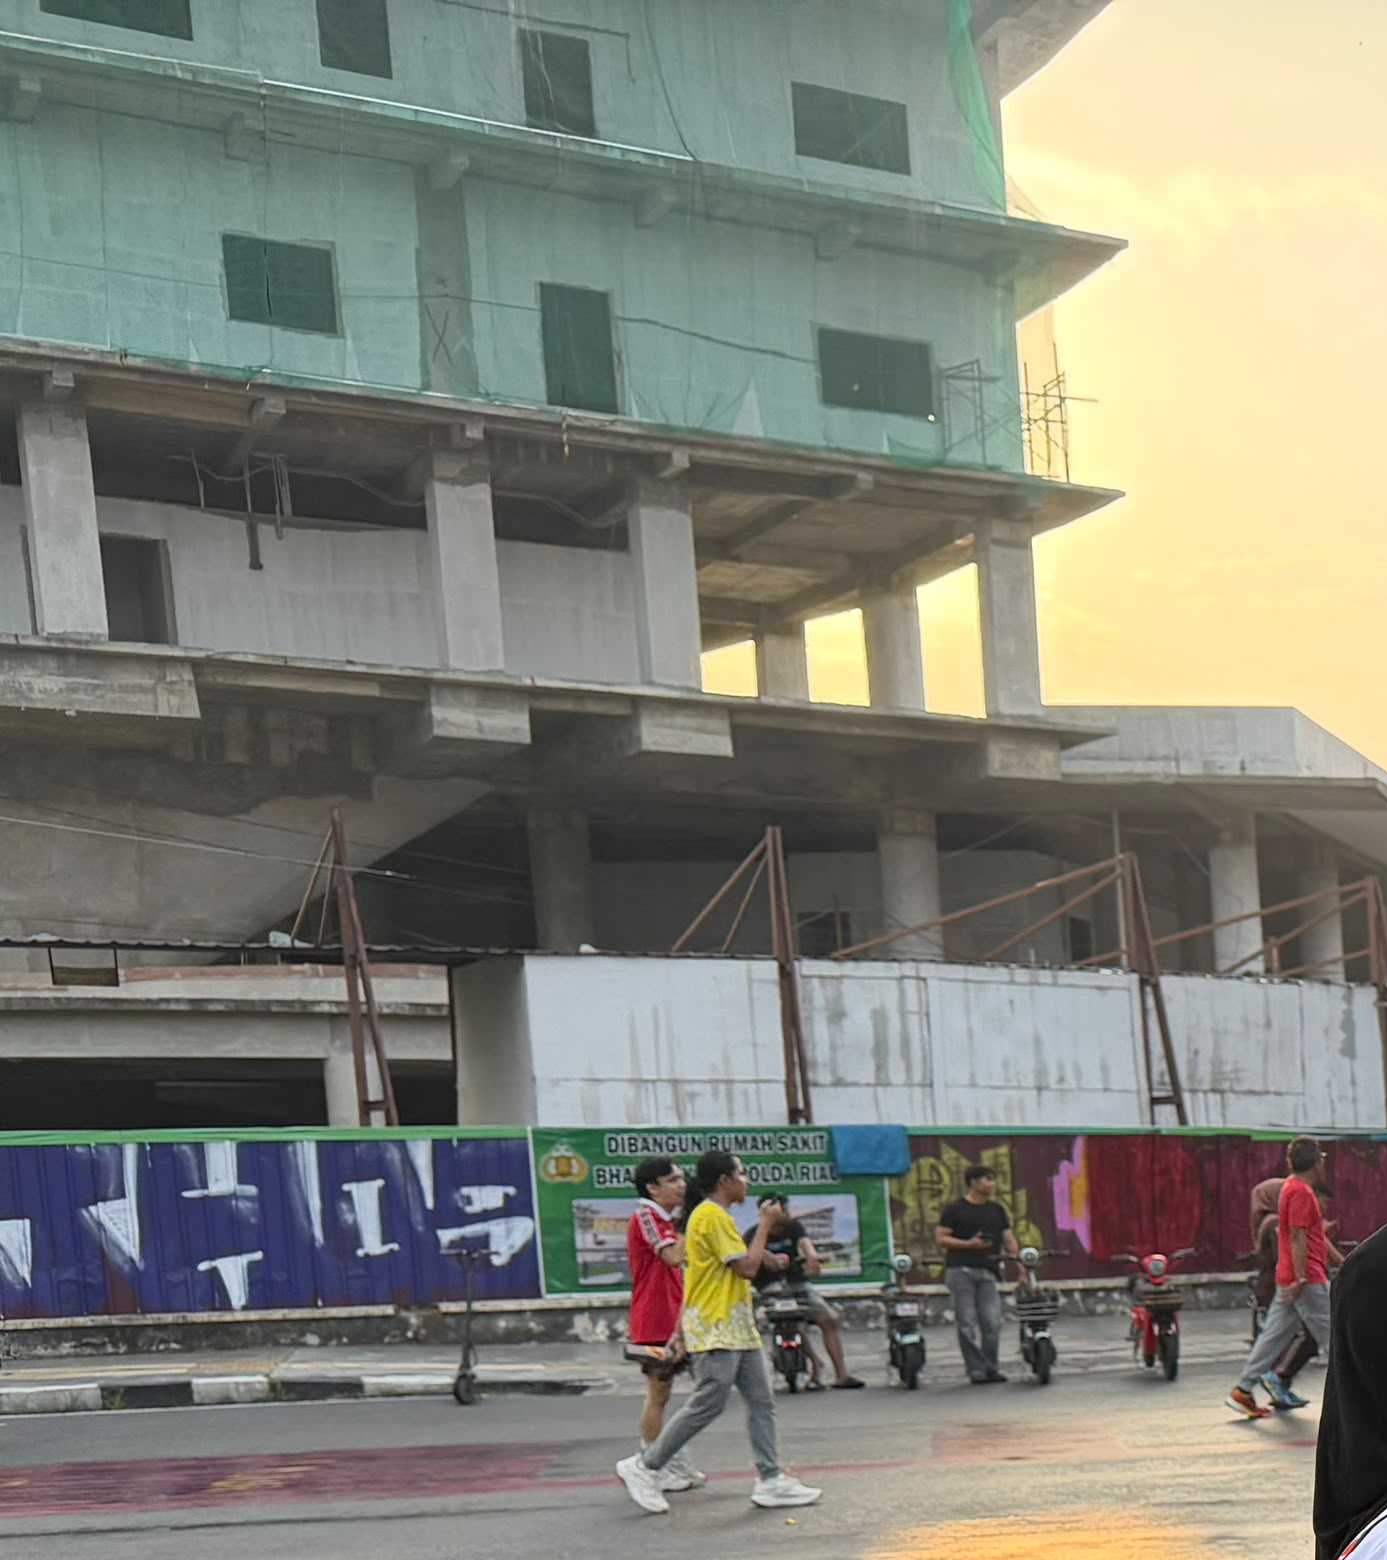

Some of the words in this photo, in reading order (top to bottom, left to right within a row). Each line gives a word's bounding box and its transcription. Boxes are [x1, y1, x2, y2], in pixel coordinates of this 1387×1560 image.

[606, 1134, 702, 1154] DIBANGUN
[709, 1134, 772, 1152] RUMAH
[778, 1134, 827, 1151] SAKIT
[746, 1163, 794, 1183] OLDA
